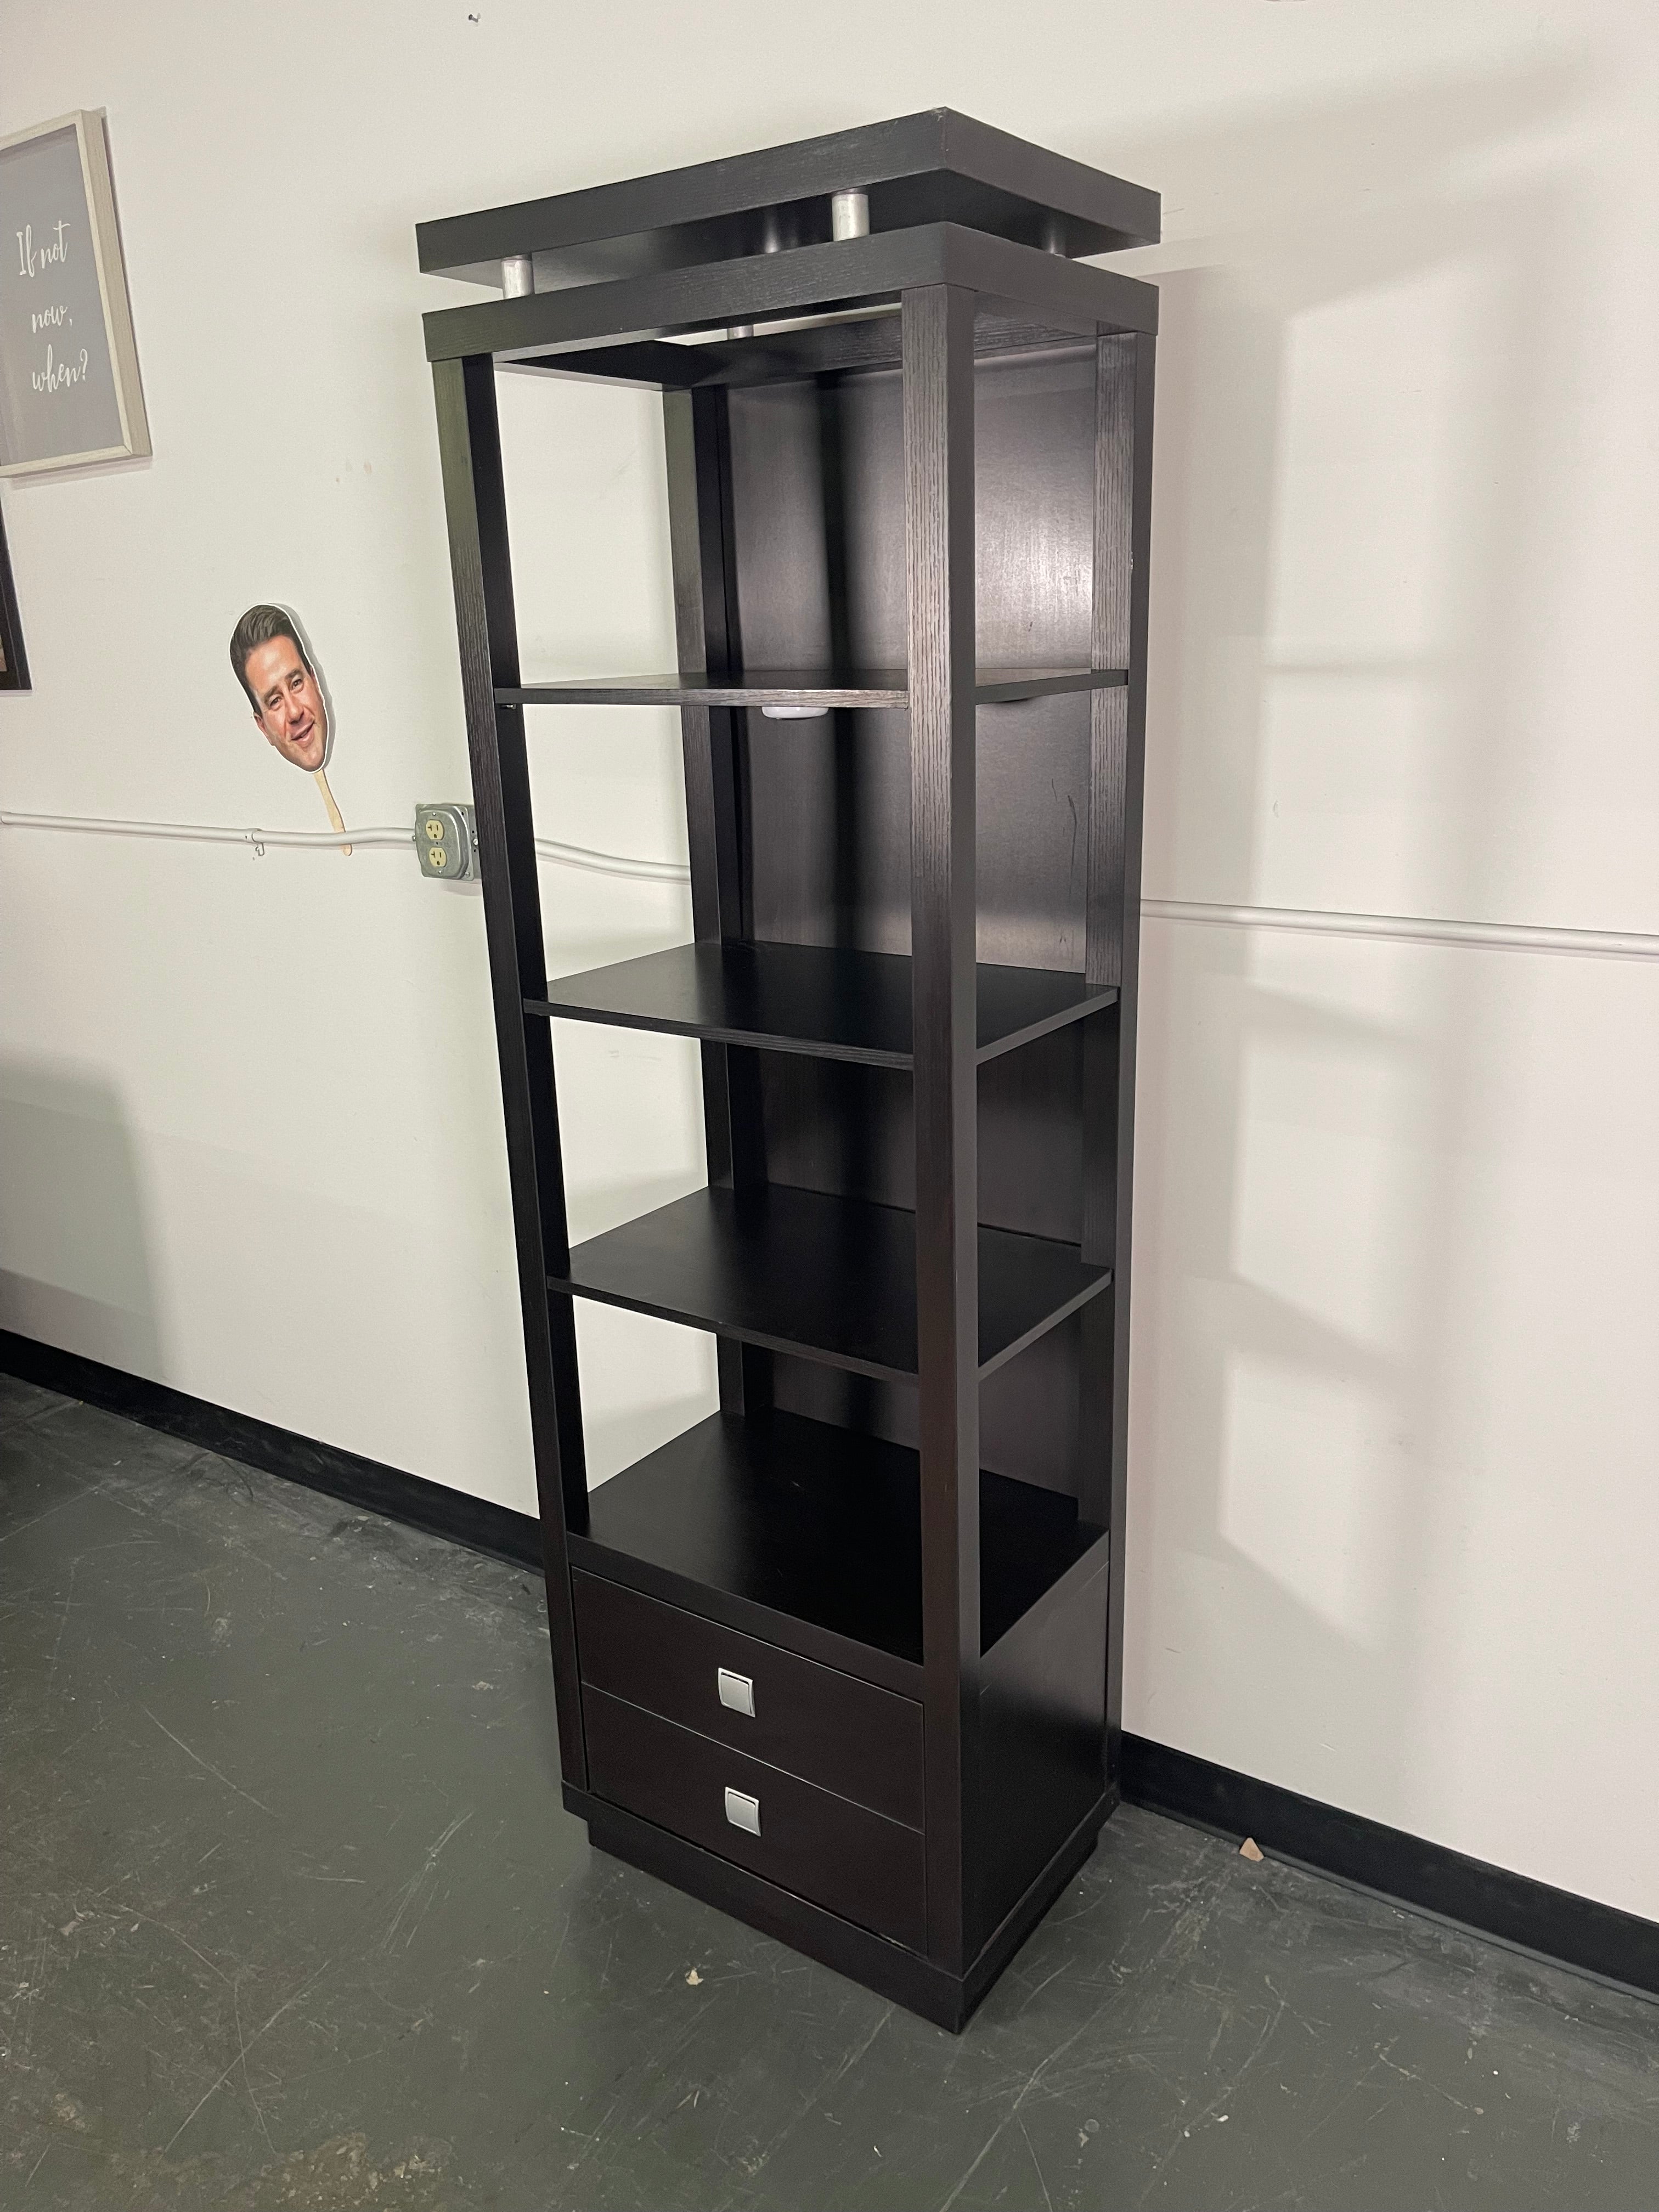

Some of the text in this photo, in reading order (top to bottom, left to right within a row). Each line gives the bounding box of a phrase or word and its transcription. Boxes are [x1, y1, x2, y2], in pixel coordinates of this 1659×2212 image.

[16, 220, 71, 277] If not
[31, 305, 73, 333] now,
[32, 344, 88, 393] when?
